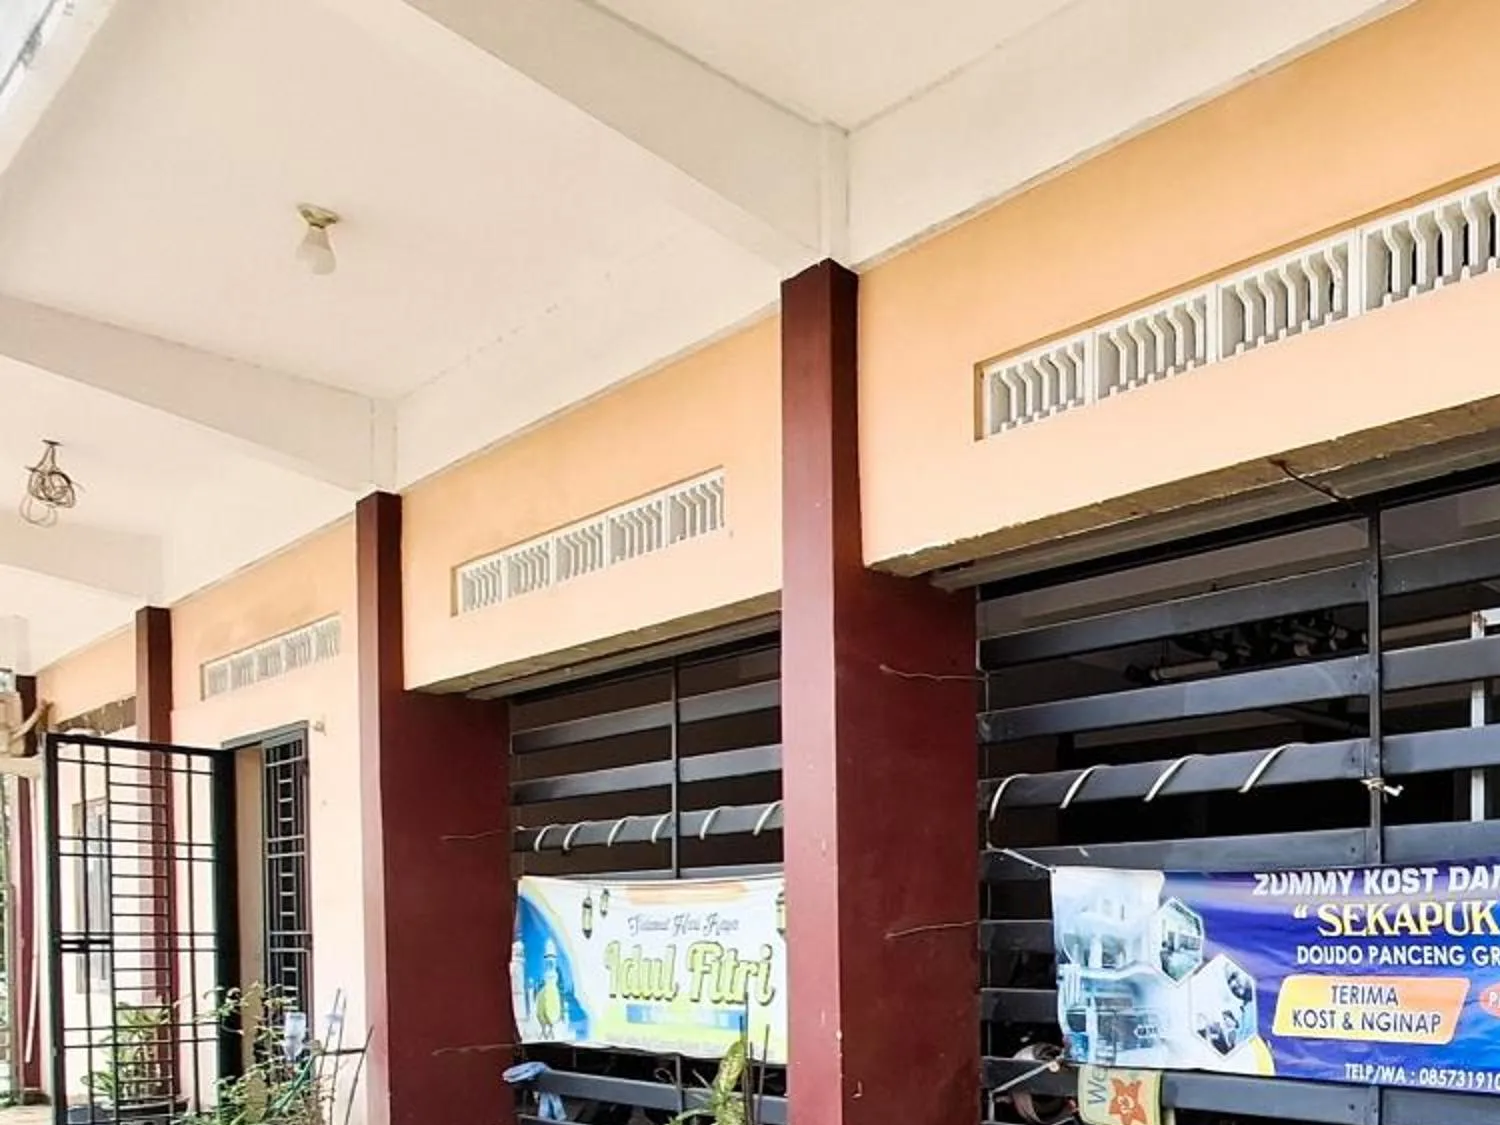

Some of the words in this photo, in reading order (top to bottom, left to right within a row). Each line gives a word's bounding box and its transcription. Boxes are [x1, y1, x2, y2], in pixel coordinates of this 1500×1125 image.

[1252, 869, 1355, 897] ZUMMY
[1363, 866, 1440, 897] KOST
[1297, 944, 1363, 966] DOUDO
[1369, 944, 1466, 966] PANCENG
[604, 939, 679, 1002] Idul
[687, 939, 776, 1006] Fitri
[1331, 984, 1399, 1006] TERIMA
[1292, 1008, 1336, 1029] KOST
[1342, 1012, 1353, 1031] &
[1361, 1011, 1442, 1034] NGINAP
[1344, 1063, 1406, 1083] TELP/WA
